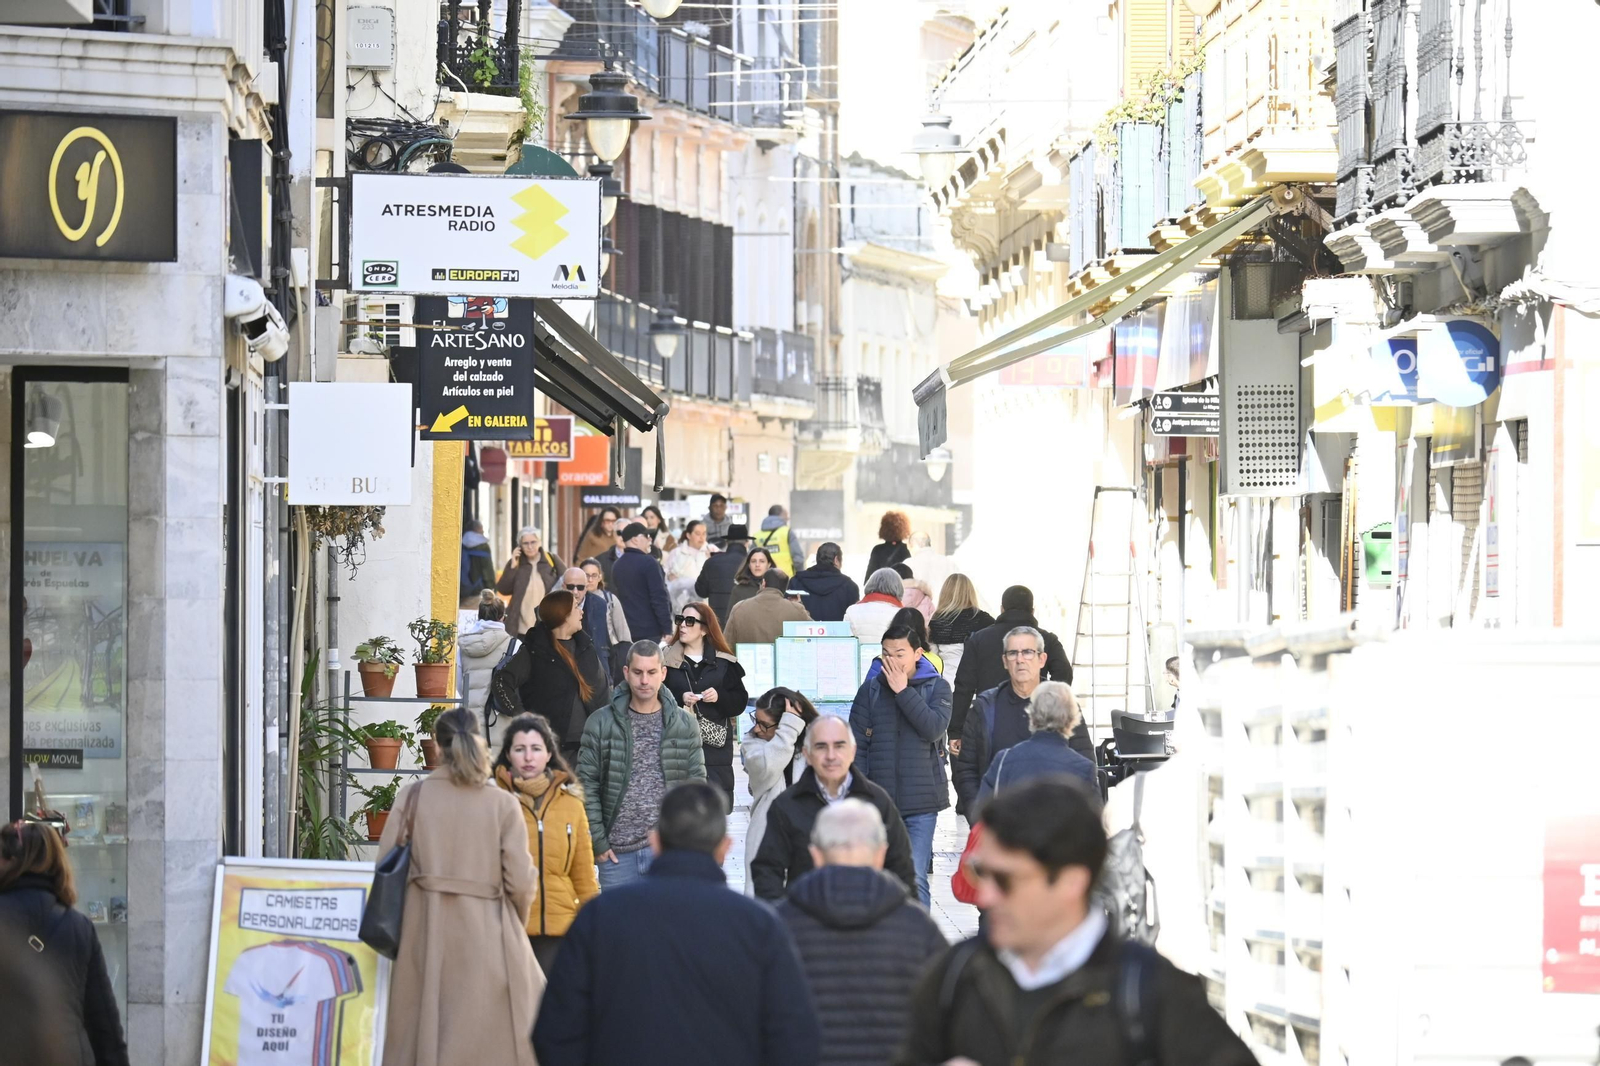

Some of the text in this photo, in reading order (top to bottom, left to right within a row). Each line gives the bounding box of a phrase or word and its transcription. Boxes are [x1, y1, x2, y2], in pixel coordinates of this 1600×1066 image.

[381, 204, 495, 218] ATRESMEDIA
[448, 220, 496, 232] RADIO
[367, 265, 393, 273] ONDA
[432, 320, 452, 331] EL
[444, 356, 512, 370] Arreglo y venta
[453, 370, 504, 382] del calzado
[442, 385, 514, 398] Artículos en piel
[467, 415, 528, 427] EN GALERIA
[507, 441, 569, 455] TABACOS
[561, 471, 604, 485] orange
[24, 551, 104, 567] HUELVA
[40, 569, 52, 577] de
[44, 578, 90, 590] Espuelas
[44, 719, 102, 734] exclusivas
[40, 735, 115, 749] personalizada
[51, 754, 80, 765] MOVIL
[265, 894, 338, 911] CAMISETAS
[242, 912, 359, 932] PERSONALIZADAS
[270, 1013, 285, 1024] TU
[256, 1026, 297, 1038] DISEÑO
